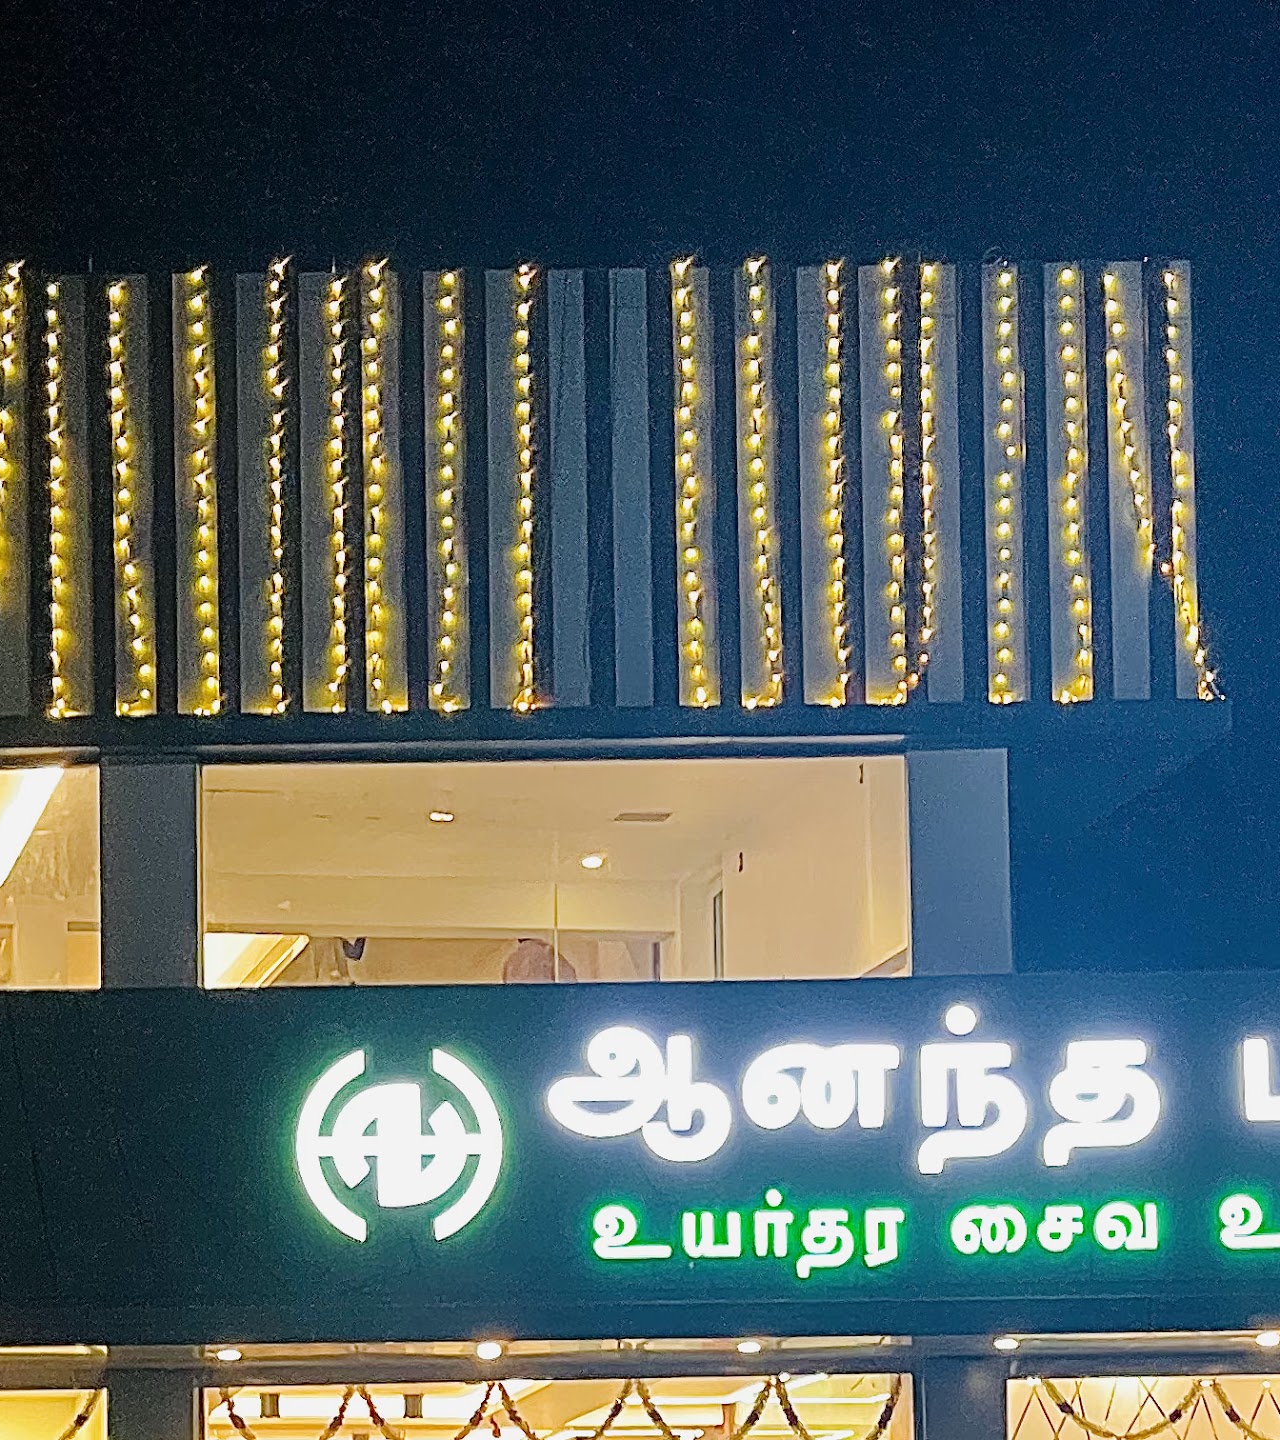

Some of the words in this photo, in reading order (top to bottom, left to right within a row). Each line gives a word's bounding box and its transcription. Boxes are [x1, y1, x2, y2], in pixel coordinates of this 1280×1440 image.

[546, 1004, 1161, 1175] ஆனந்த
[592, 1188, 905, 1279] உயர்தர
[950, 1201, 1159, 1255] சைவ
